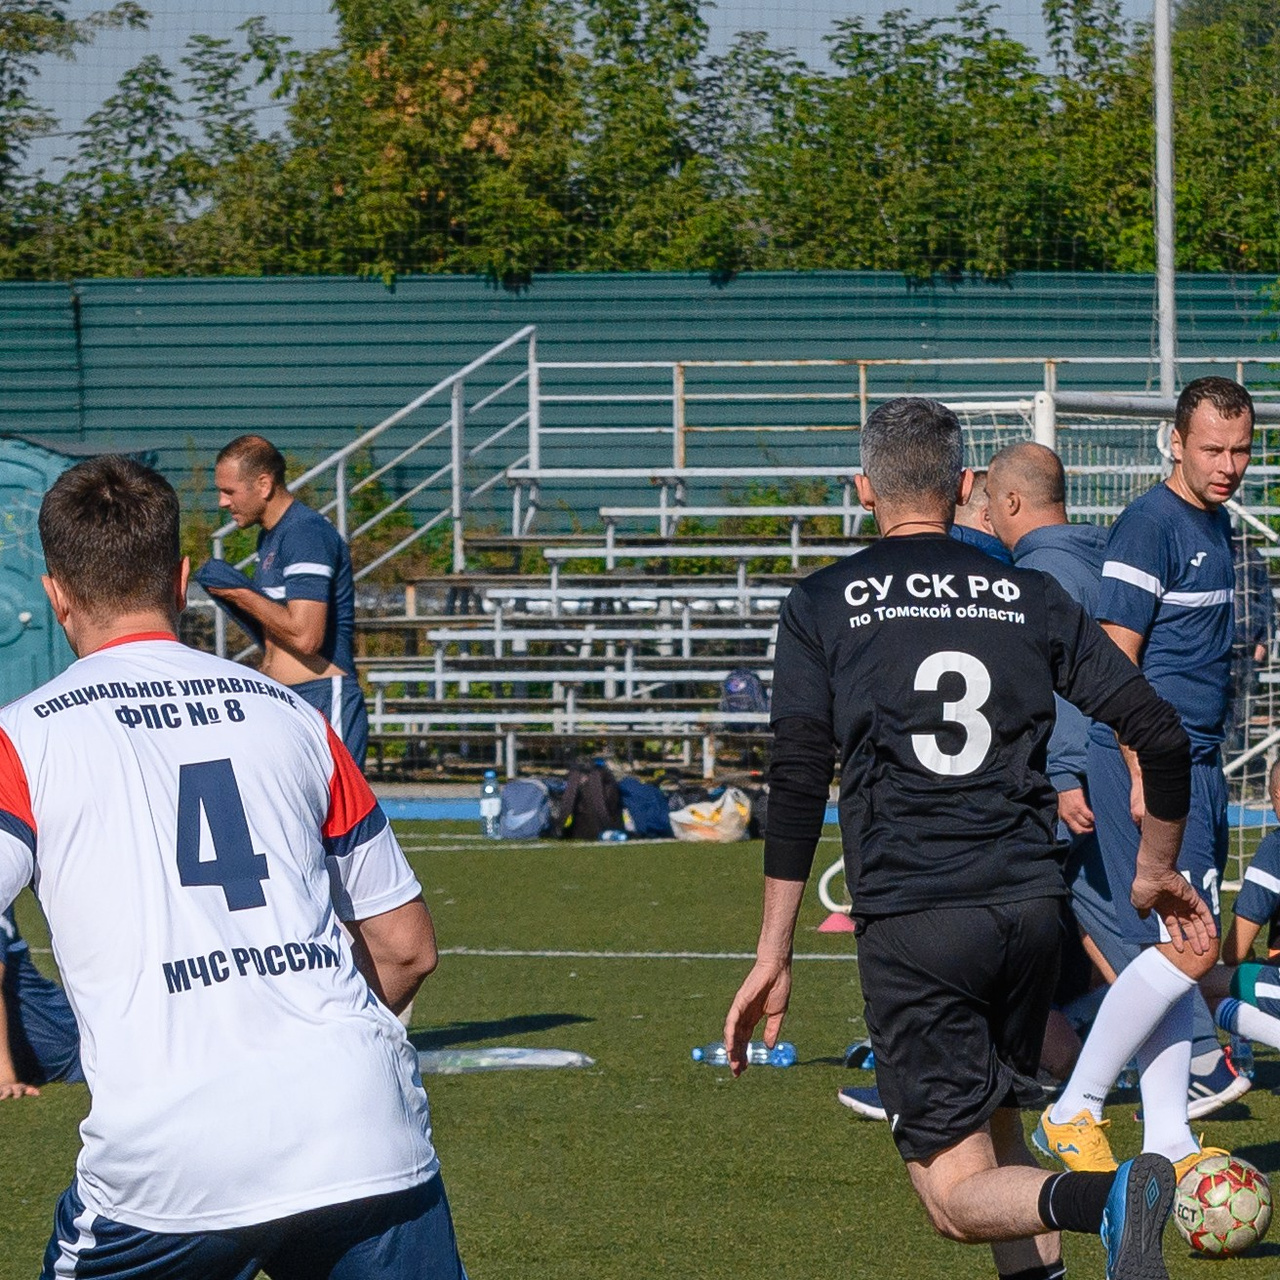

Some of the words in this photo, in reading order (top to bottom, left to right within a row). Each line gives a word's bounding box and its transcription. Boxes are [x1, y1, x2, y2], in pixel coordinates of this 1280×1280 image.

[844, 574, 893, 606] СУ
[906, 573, 959, 598] СК
[967, 575, 1021, 602] РФ
[850, 613, 871, 628] по
[874, 604, 951, 621] Томской
[956, 604, 1025, 624] области
[33, 680, 177, 719] СПЕЦИАЛЬНОЕ
[177, 677, 298, 709] УПРАВЛЕНИЕ
[115, 703, 182, 729] ФПС
[185, 701, 222, 726] №
[227, 699, 246, 723] 8
[911, 651, 991, 776] 3
[176, 758, 270, 912] 4
[162, 950, 230, 994] МЧС
[231, 942, 340, 976] РОССИИ
